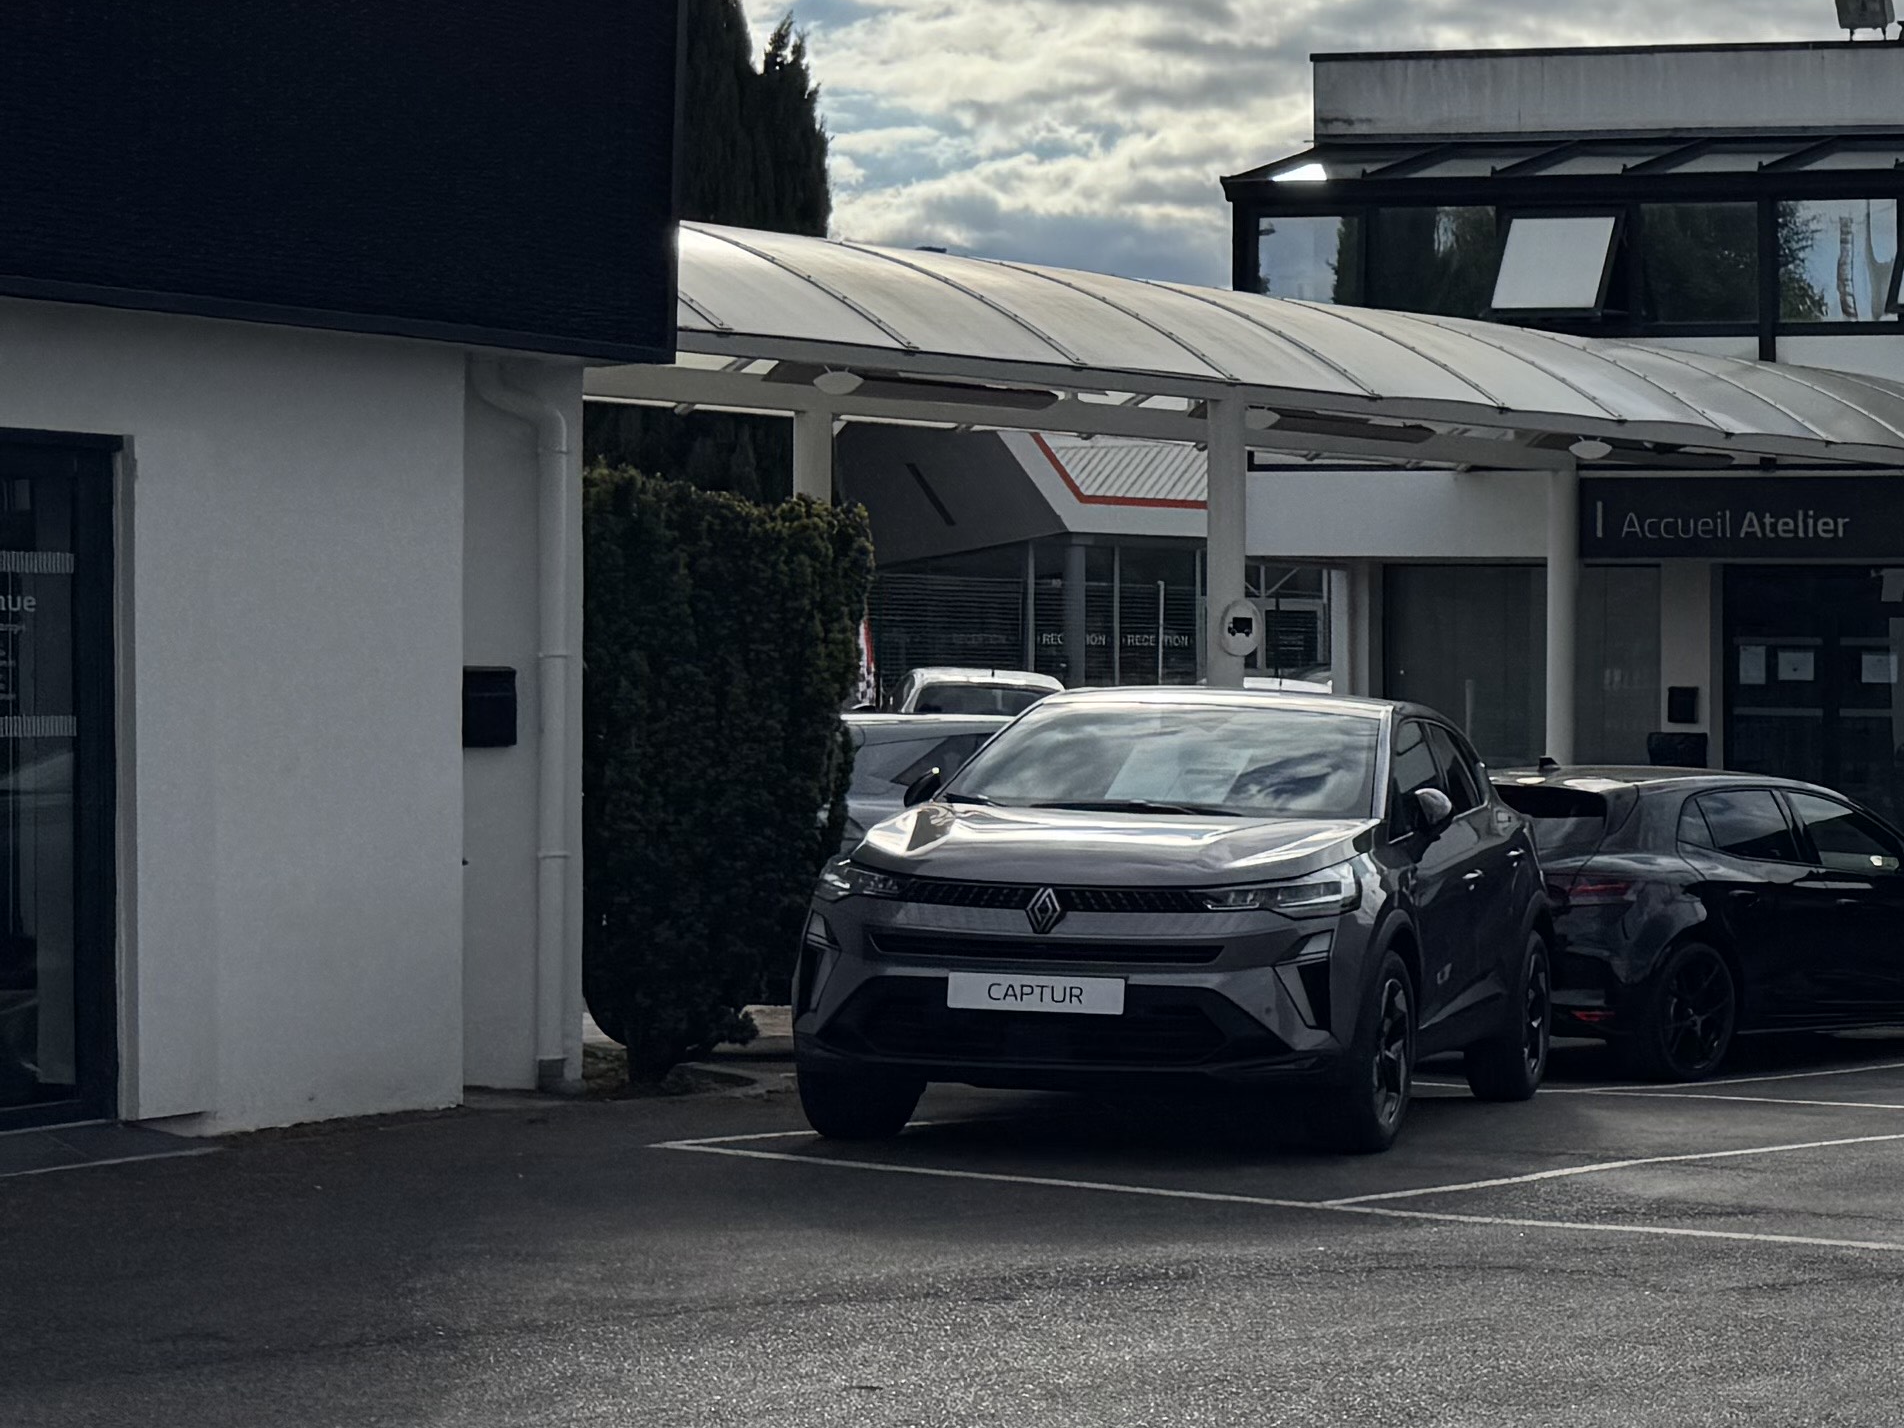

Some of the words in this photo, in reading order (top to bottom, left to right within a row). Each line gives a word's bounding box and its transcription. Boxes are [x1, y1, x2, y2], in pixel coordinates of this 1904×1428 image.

[1620, 509, 1732, 539] Accueil
[1739, 509, 1851, 539] Atelier
[1041, 632, 1106, 646] RECION
[1126, 634, 1189, 647] RECETION
[987, 982, 1084, 1005] CAPTUR
